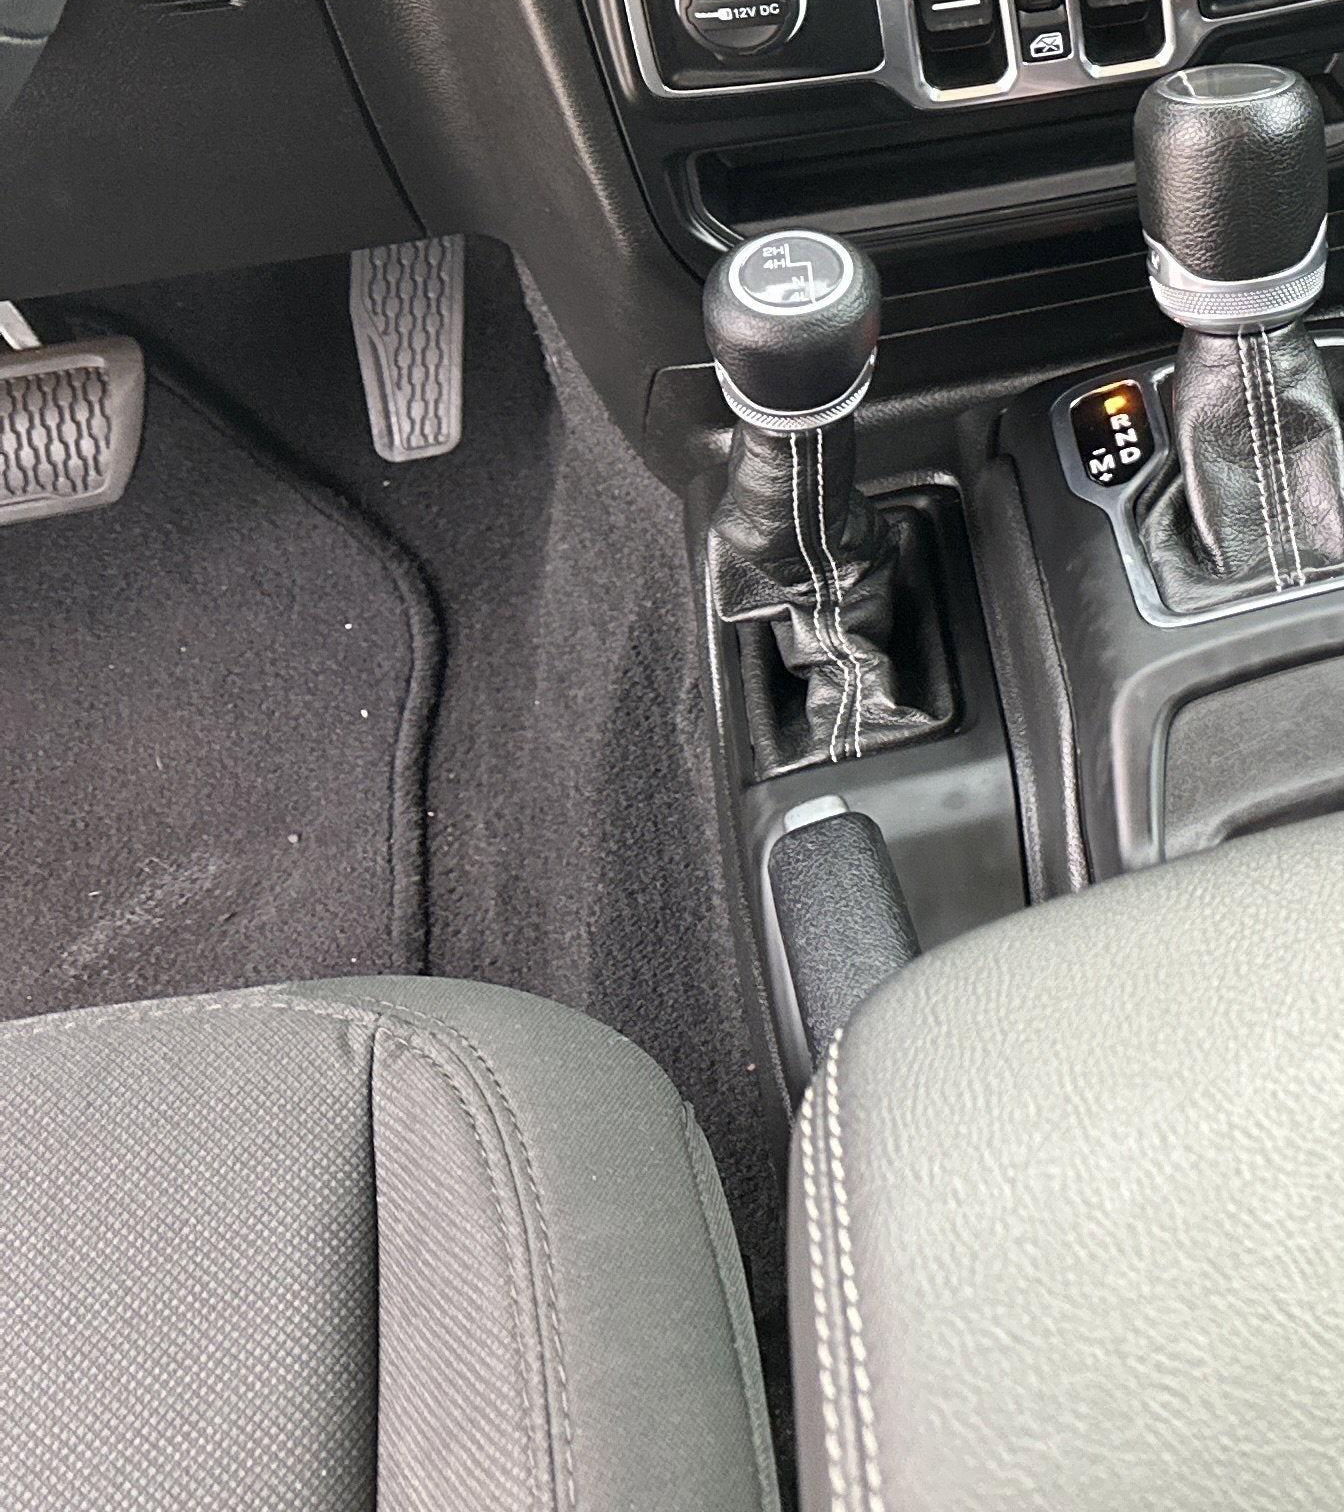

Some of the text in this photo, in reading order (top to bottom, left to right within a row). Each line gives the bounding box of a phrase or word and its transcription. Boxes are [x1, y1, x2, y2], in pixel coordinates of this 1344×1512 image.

[733, 3, 780, 19] 12V DC
[762, 245, 785, 257] 2H
[763, 258, 785, 270] 4H
[1110, 413, 1132, 430] R
[1114, 427, 1138, 447] N
[1089, 453, 1116, 474] M
[1119, 446, 1142, 465] D
